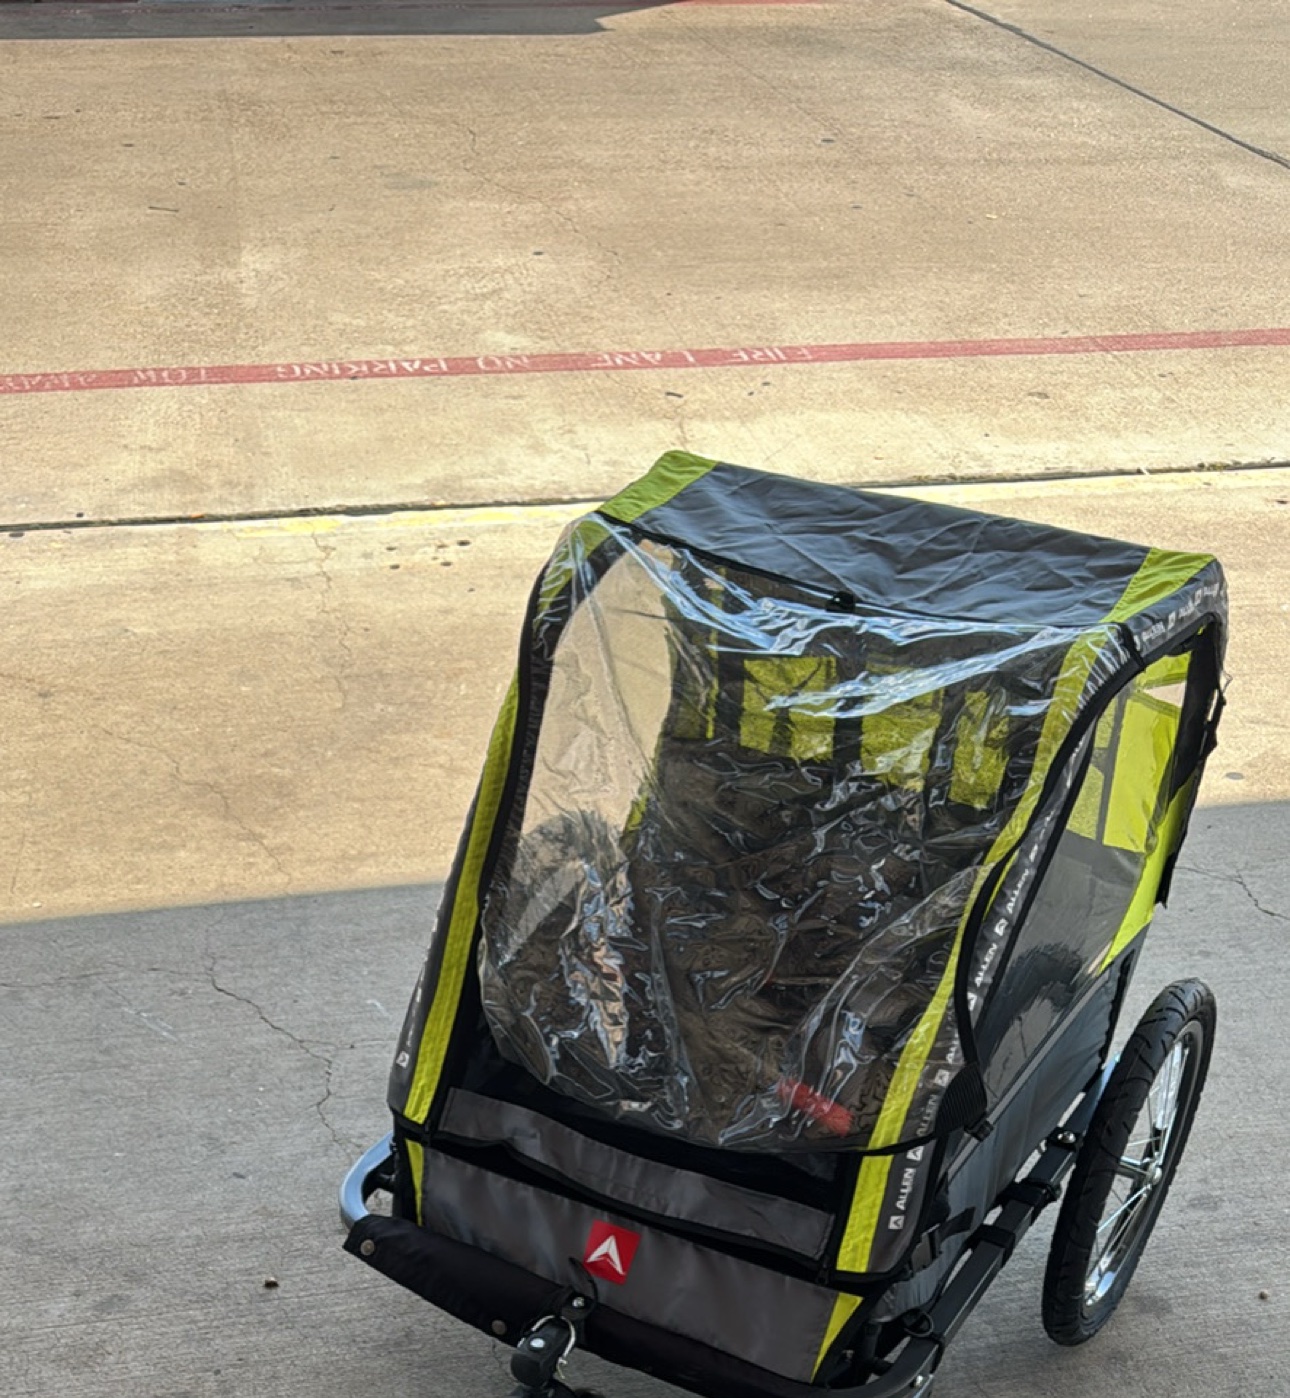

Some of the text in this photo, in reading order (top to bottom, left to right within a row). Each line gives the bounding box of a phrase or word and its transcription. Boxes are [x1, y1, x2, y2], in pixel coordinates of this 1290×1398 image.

[475, 355, 530, 372] NO
[590, 349, 697, 368] LANE
[728, 346, 813, 363] FIRE
[276, 358, 448, 379] PARKING
[974, 942, 998, 988] ALLEN
[896, 1167, 917, 1211] ALLEN
